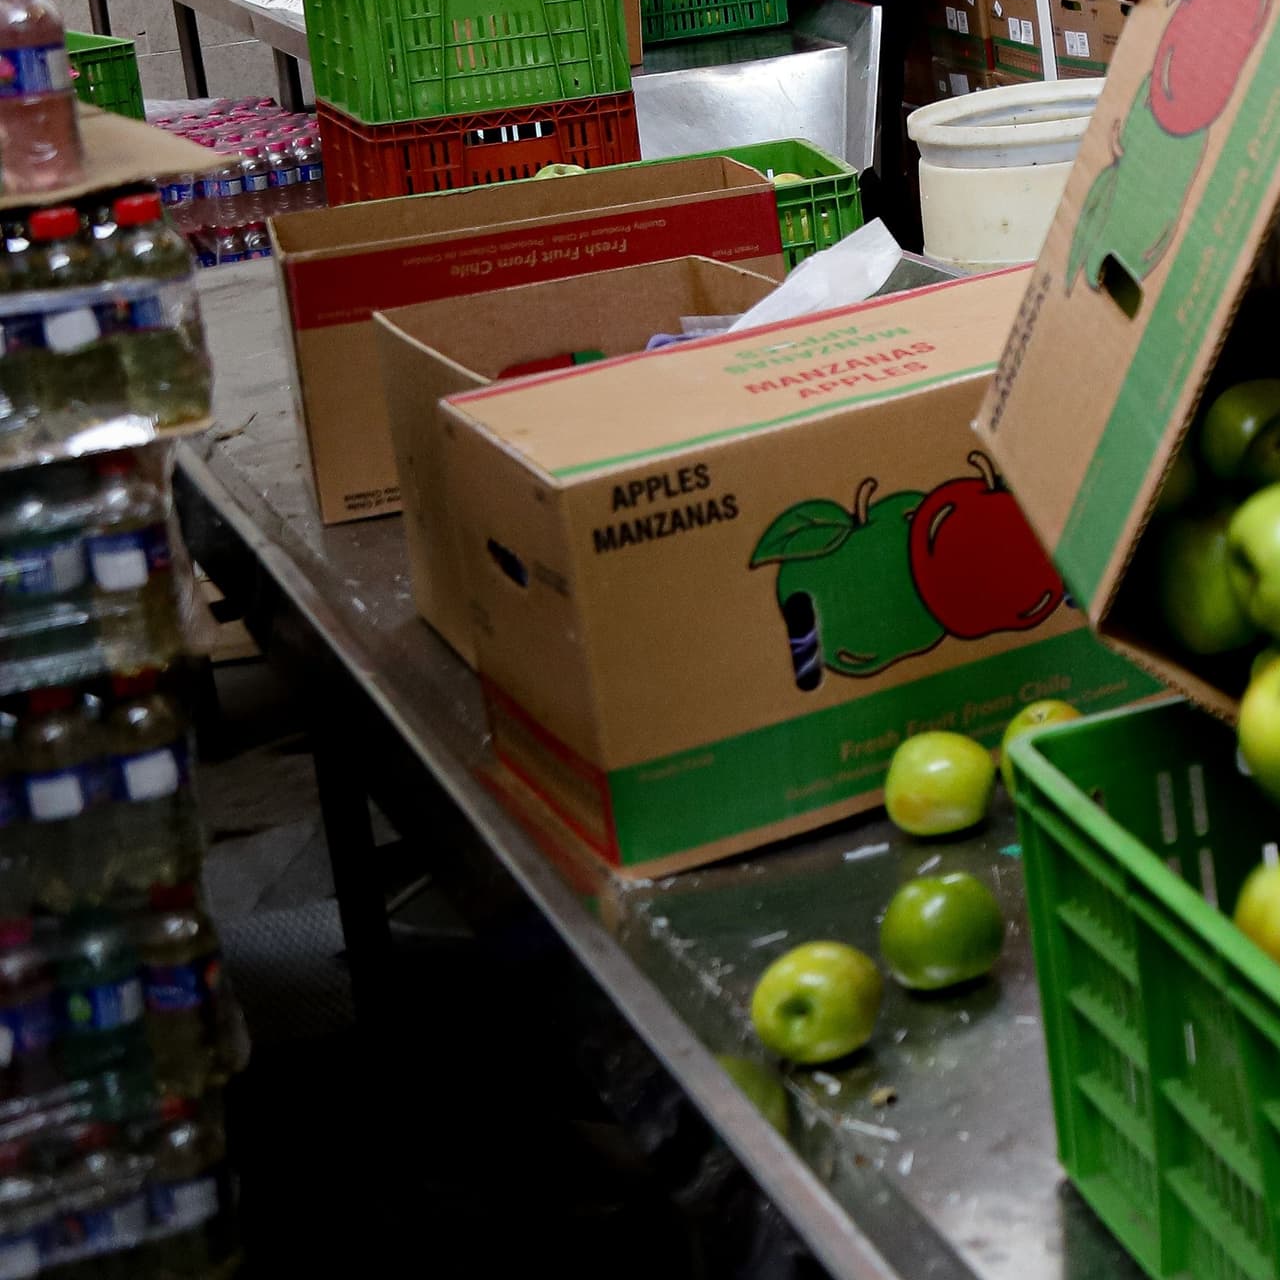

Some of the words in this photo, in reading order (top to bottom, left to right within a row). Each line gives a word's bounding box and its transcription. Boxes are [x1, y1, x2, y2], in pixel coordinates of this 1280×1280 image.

[744, 341, 936, 395] MANZANAS
[798, 361, 928, 399] APPLES
[611, 463, 711, 513] APPLES
[592, 493, 740, 554] MANZANAS
